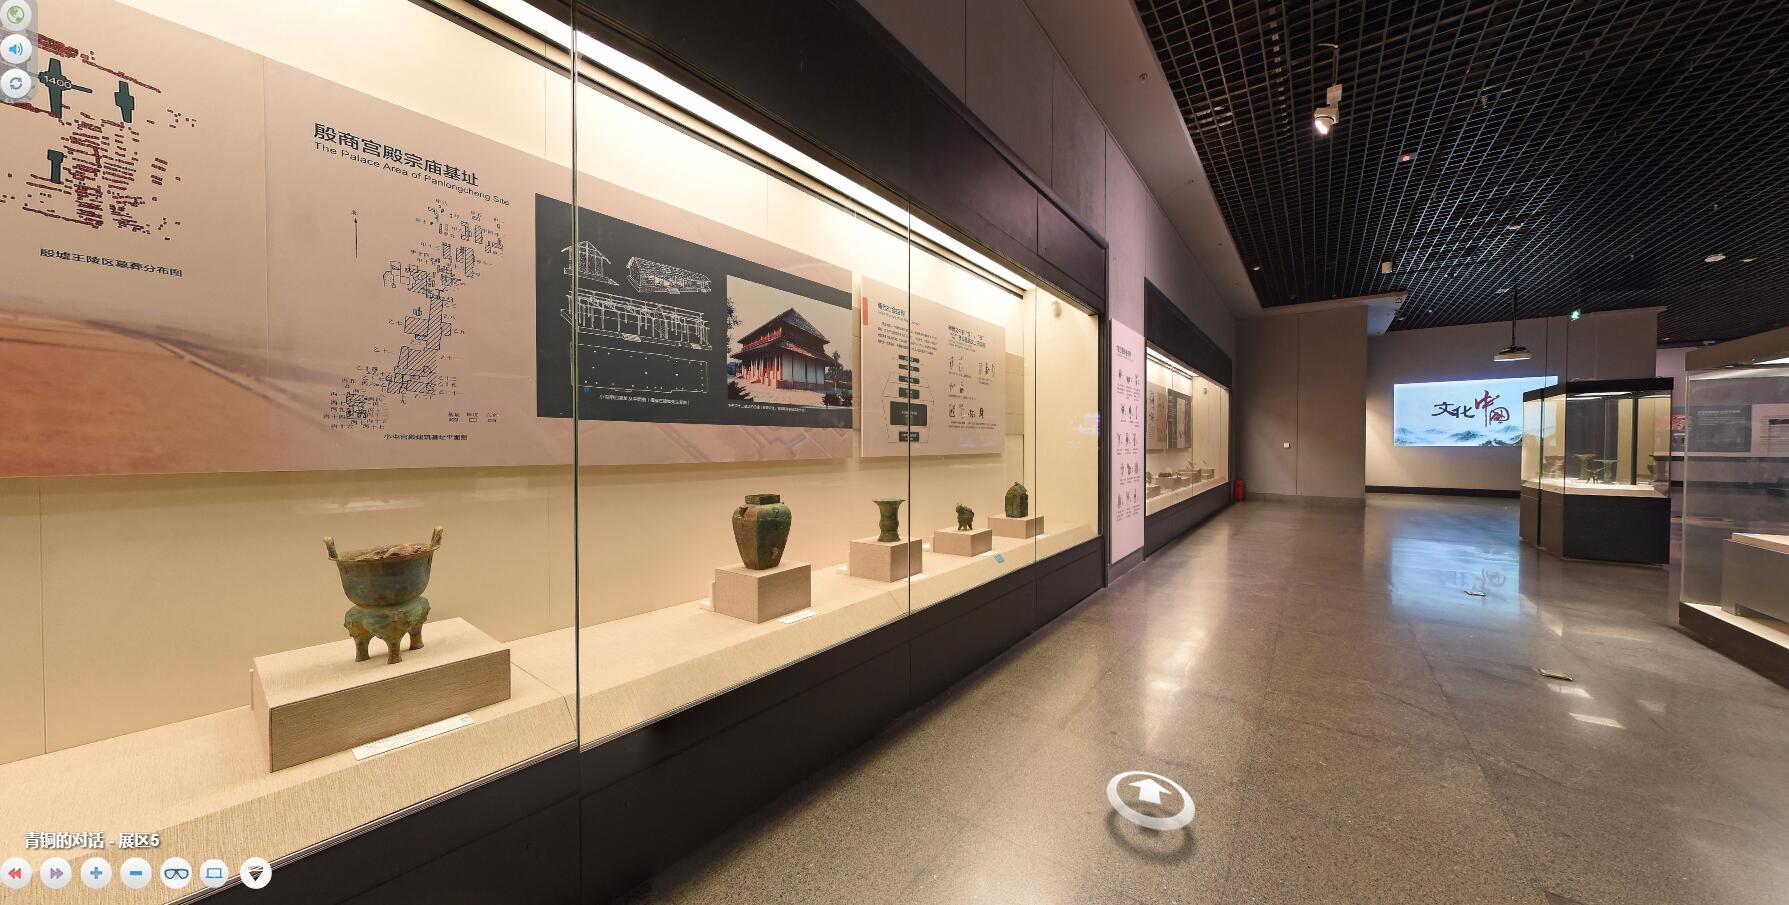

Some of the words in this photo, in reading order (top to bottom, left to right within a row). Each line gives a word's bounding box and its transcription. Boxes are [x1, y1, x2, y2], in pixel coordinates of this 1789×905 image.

[45, 75, 72, 89] 1400
[314, 122, 479, 187] 殷商宫殿宗庙基址
[315, 141, 337, 155] The
[341, 149, 380, 168] Palace
[383, 163, 408, 176] Area
[411, 171, 422, 180] of
[424, 174, 490, 202] Panlongcheng
[493, 194, 510, 207] Site
[40, 248, 182, 278] 殷墟王陵区墓葬分布图
